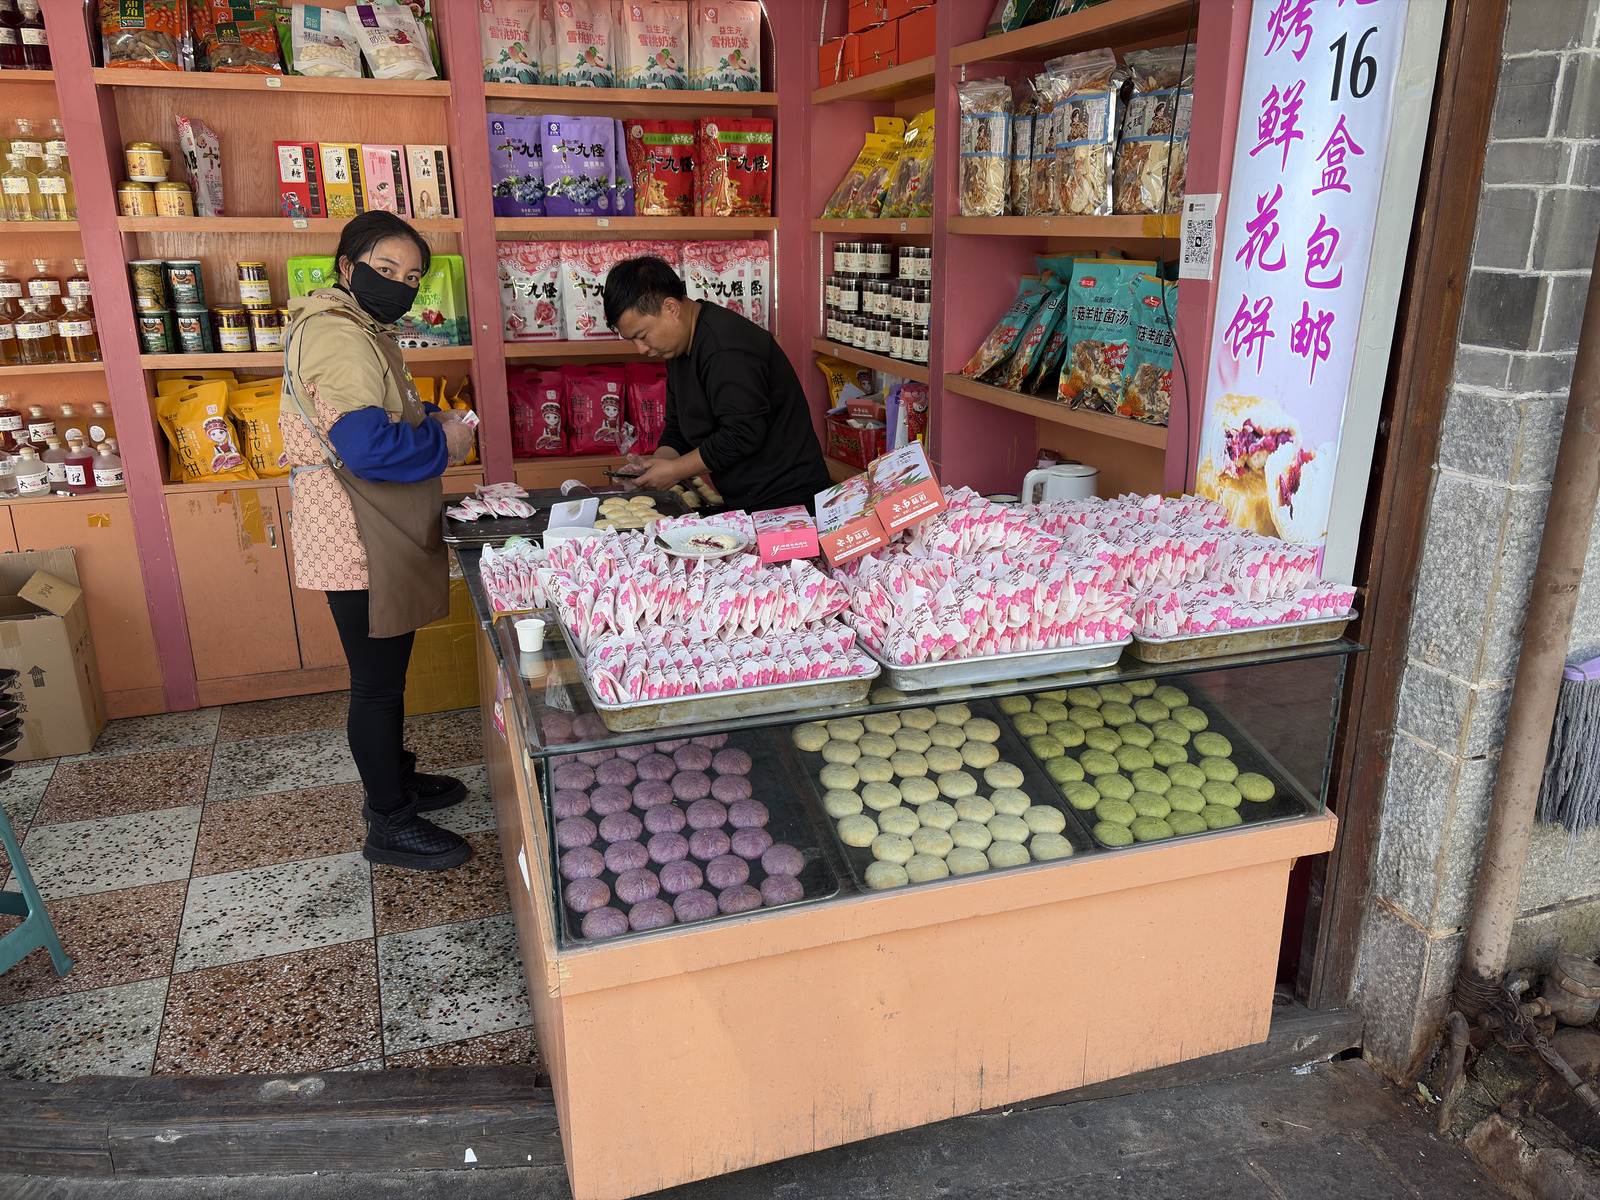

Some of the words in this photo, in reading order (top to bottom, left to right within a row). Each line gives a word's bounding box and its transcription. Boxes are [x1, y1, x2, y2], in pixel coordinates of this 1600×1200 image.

[489, 25, 530, 42] 雪桃奶冻
[566, 30, 607, 46] 雪桃奶冻
[638, 34, 679, 48] 雪桃奶冻
[710, 35, 750, 49] 雪桃奶冻
[552, 138, 605, 163] 十九怪
[643, 150, 694, 173] 十九怪
[716, 148, 770, 173] 十九怪
[1224, 0, 1314, 375] 烤鲜花饼
[1290, 0, 1381, 387] 16盒包邮
[504, 276, 558, 300] 十九怪
[573, 276, 605, 299] 十九
[695, 276, 746, 298] 十九怪
[1071, 305, 1133, 327] 菇羊肚菌汤
